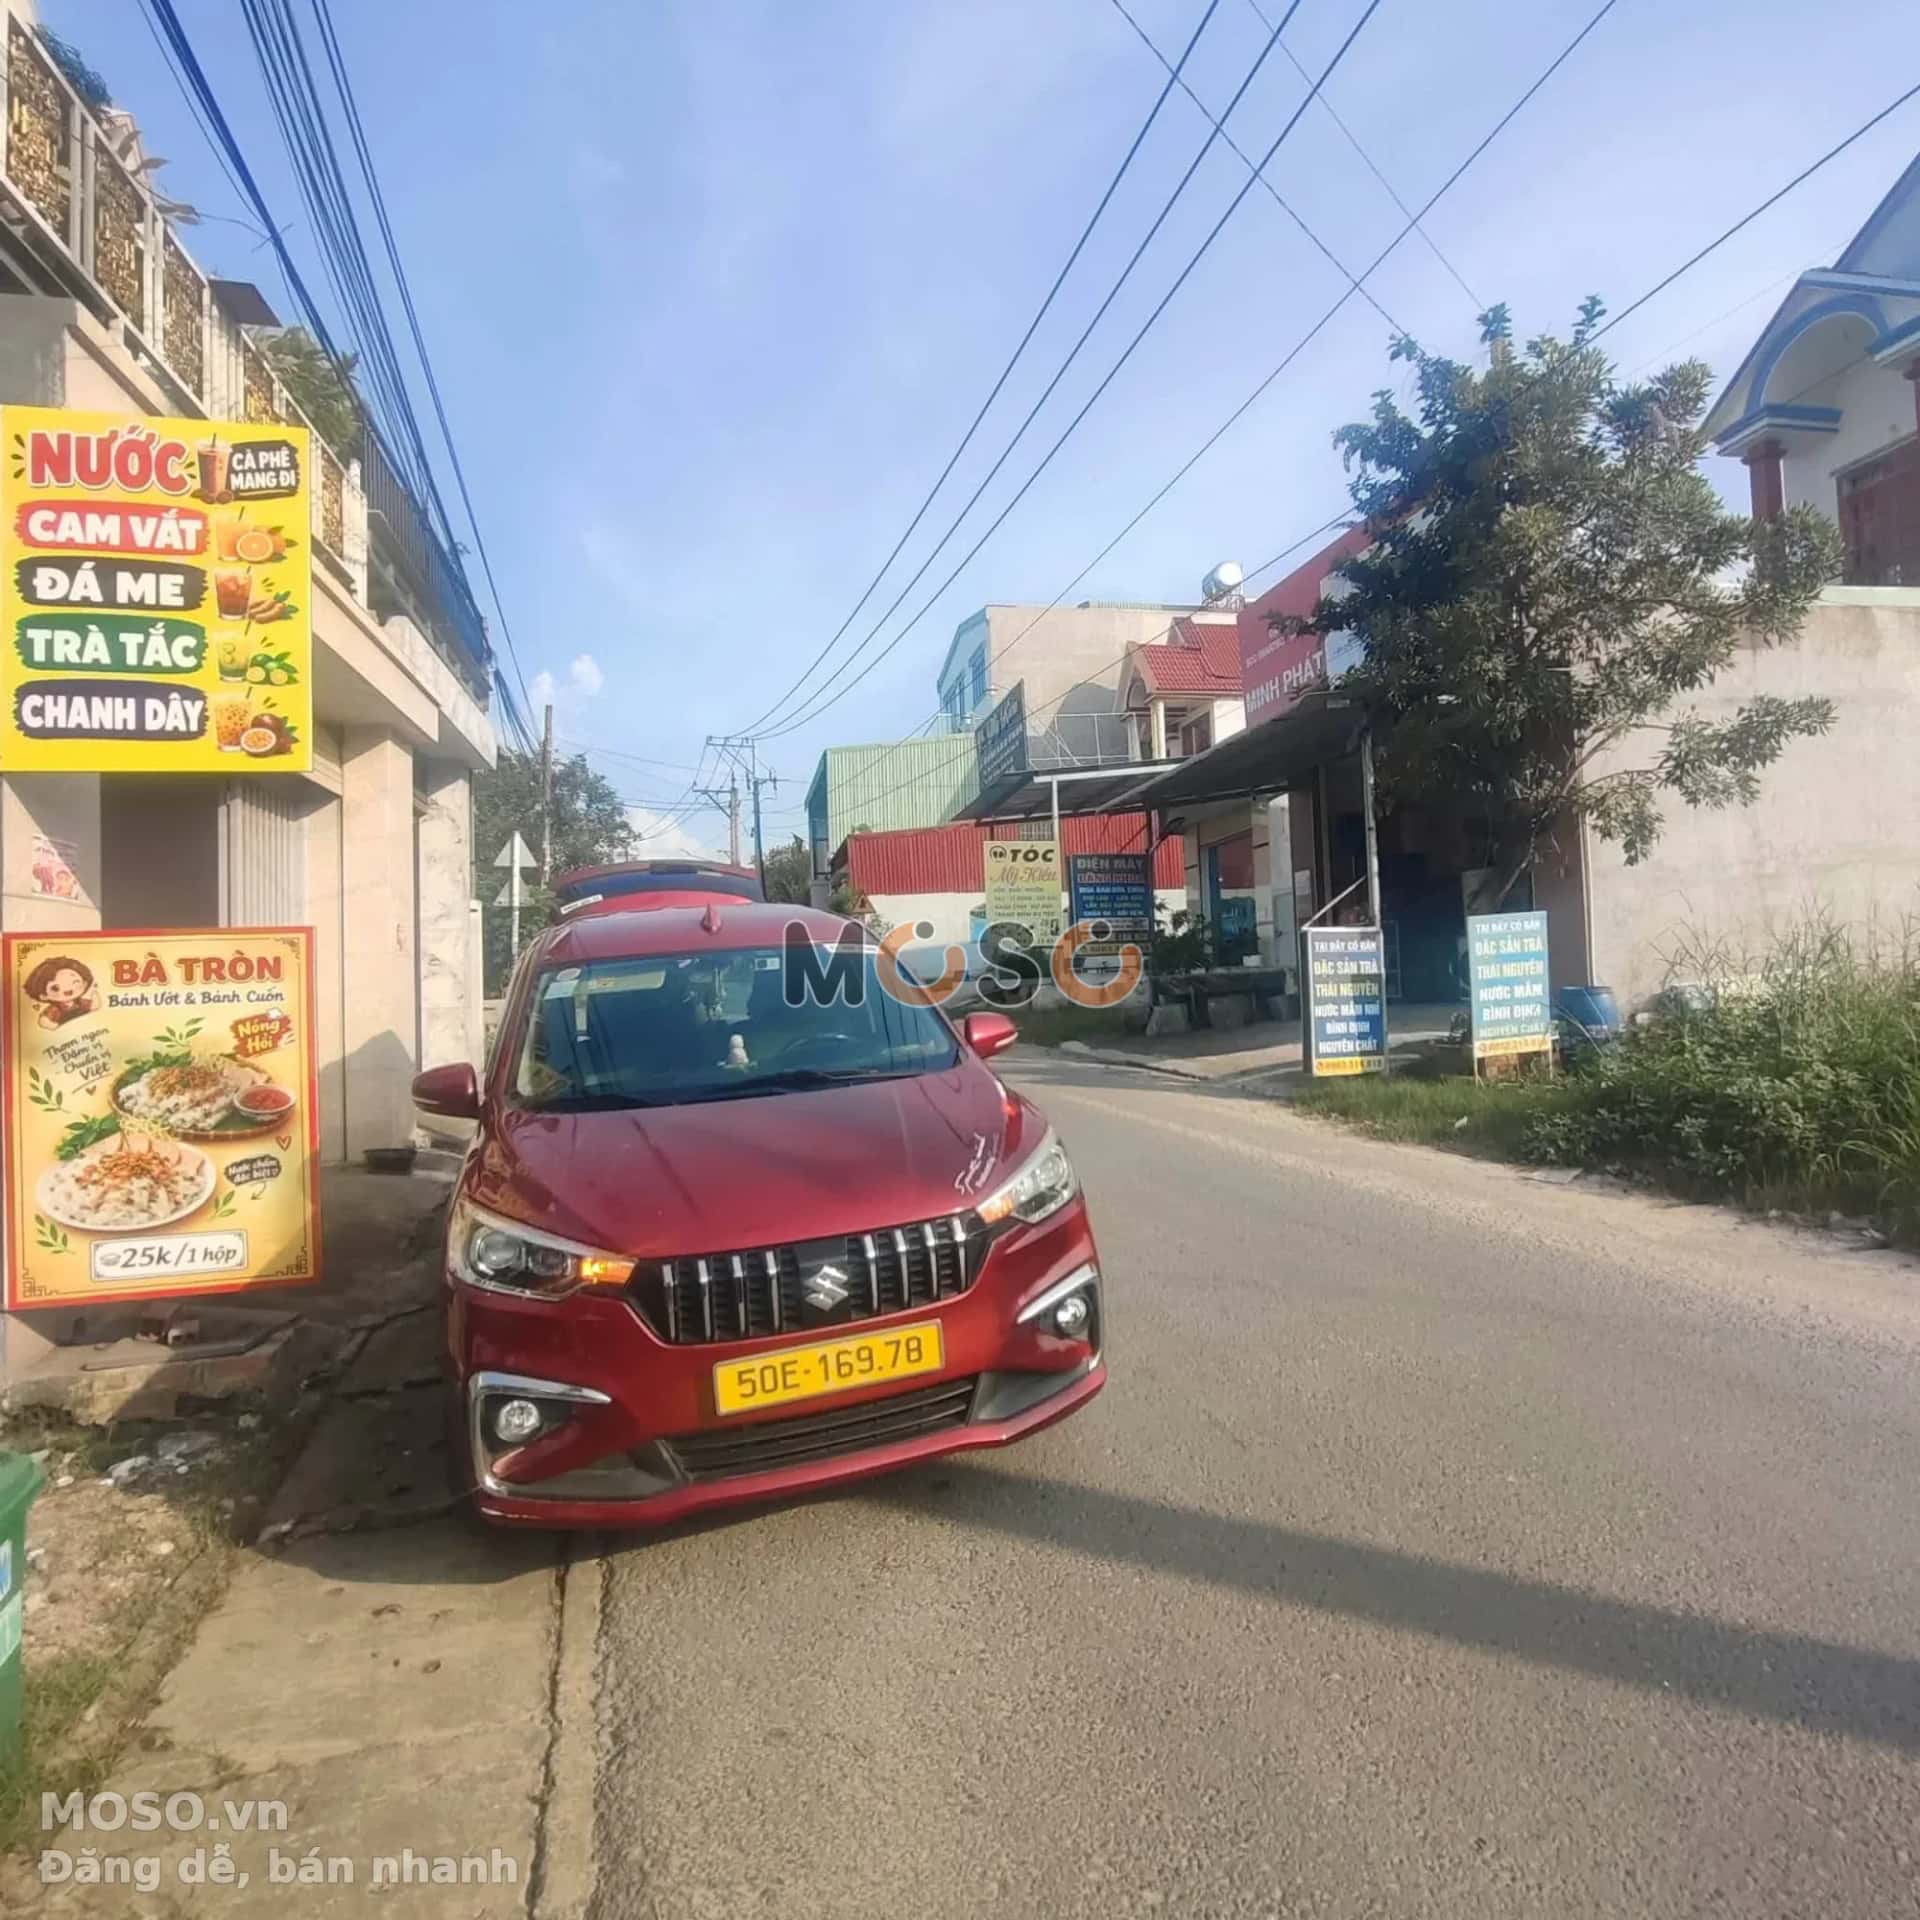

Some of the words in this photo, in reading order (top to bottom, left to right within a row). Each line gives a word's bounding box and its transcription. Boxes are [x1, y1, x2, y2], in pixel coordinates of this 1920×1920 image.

[31, 425, 189, 493] NƯỚC
[232, 450, 256, 471] CÀ
[259, 446, 291, 468] PHÊ
[230, 472, 277, 490] MANG
[279, 469, 296, 486] ĐI
[28, 509, 121, 546] CAM
[129, 508, 203, 550] VẮT
[32, 562, 104, 602] ĐÁ
[116, 571, 185, 607] ME
[26, 624, 111, 665] TRÀ
[119, 622, 198, 668] TẮC
[1246, 676, 1280, 713] MINH
[1283, 650, 1323, 693] PHÁT
[21, 695, 136, 731] CHANH
[145, 692, 204, 732] DÂY
[1010, 844, 1055, 863] TÓC
[112, 952, 168, 985] BÀ
[175, 949, 283, 983] TRÒN
[108, 993, 149, 1008] Bánh
[184, 992, 196, 1005] &
[201, 990, 240, 1004] Bánh
[247, 987, 284, 1002] Cuốn
[238, 1018, 281, 1040] Nóng
[202, 1245, 238, 1265] hộp
[738, 1336, 923, 1399] 50E-169.78
